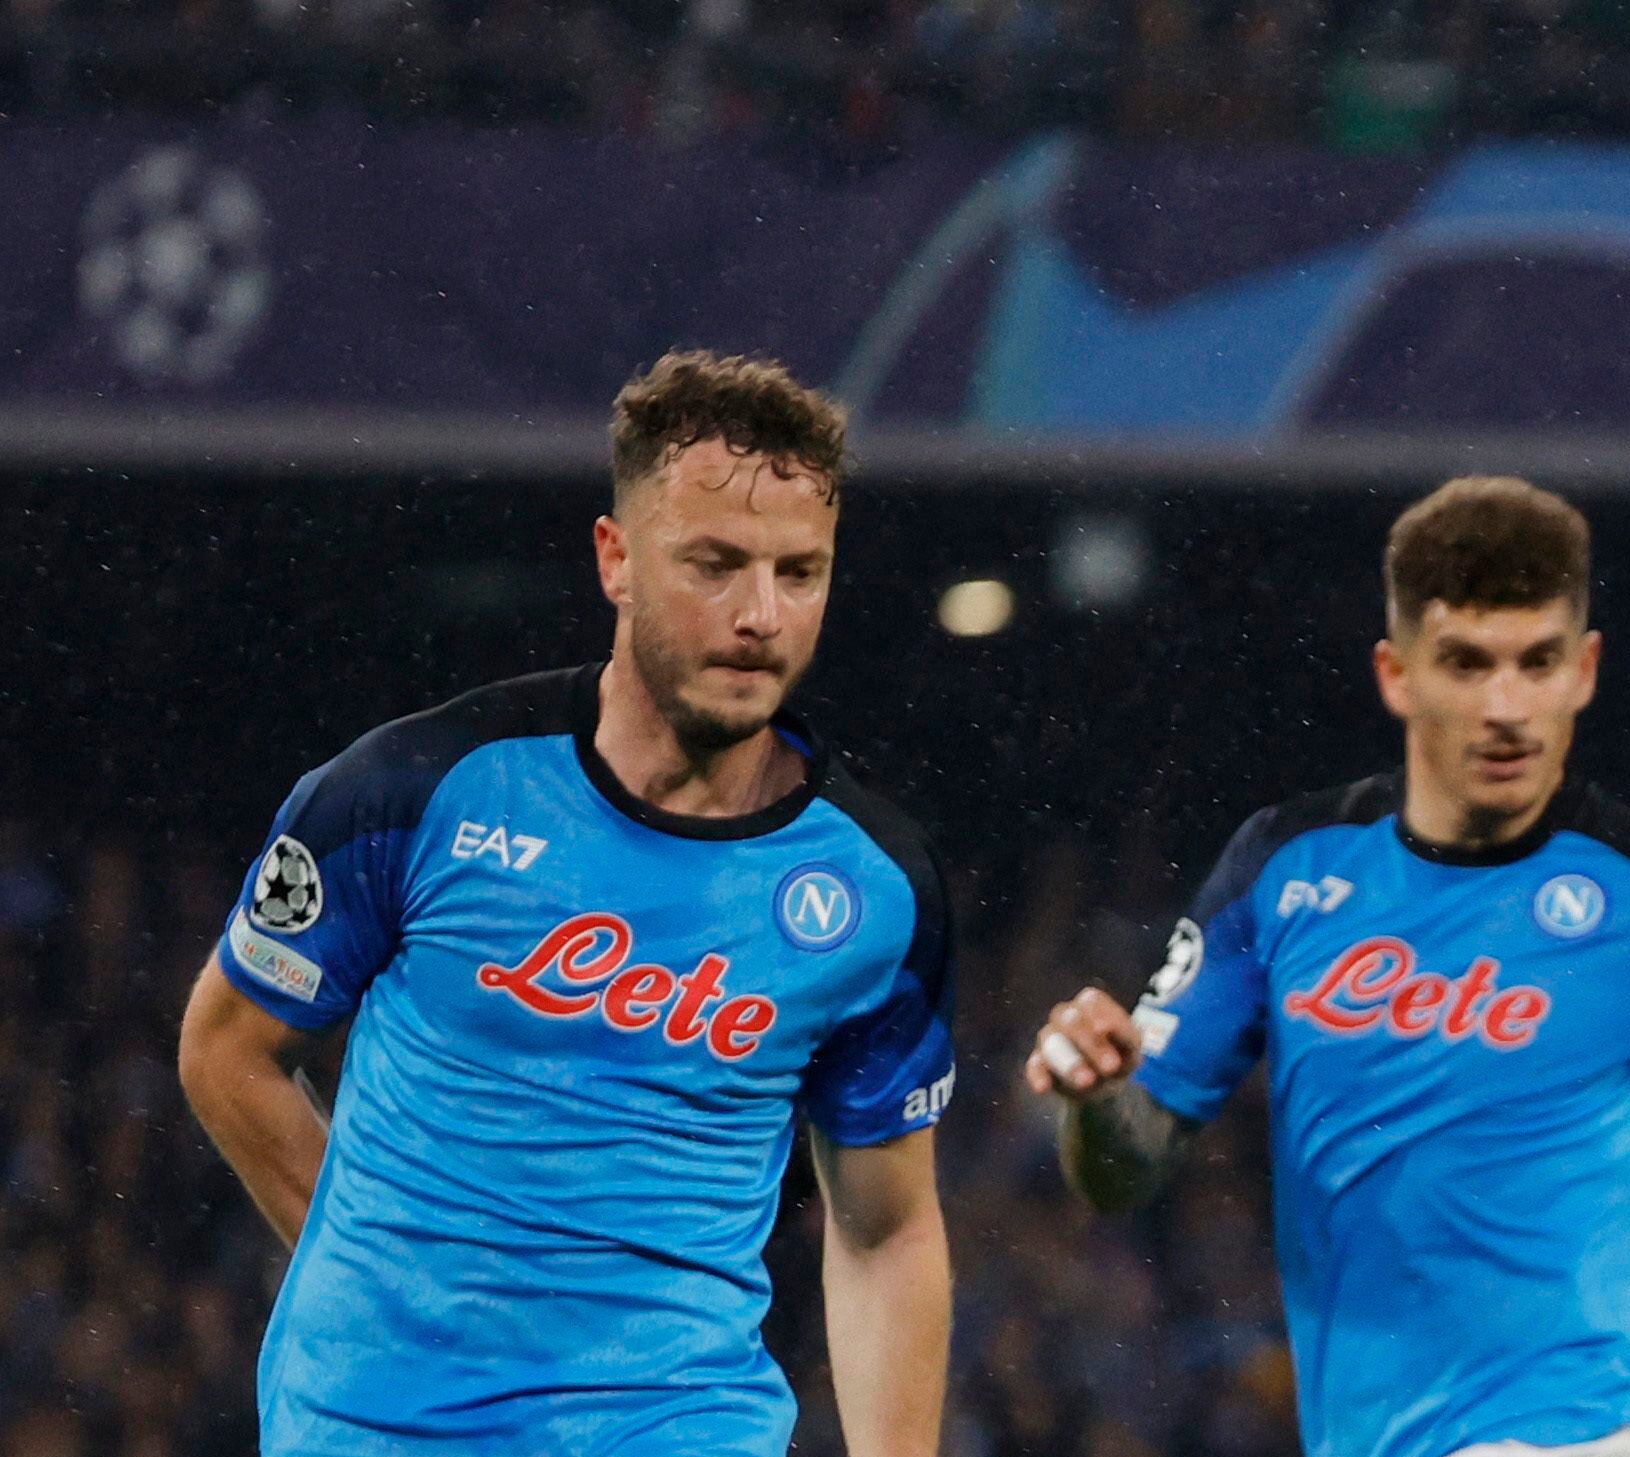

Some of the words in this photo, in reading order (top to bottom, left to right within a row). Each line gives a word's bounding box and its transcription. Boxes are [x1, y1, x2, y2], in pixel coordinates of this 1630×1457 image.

[451, 820, 549, 873] EA7
[477, 912, 778, 1063] Lete
[1283, 934, 1552, 1053] Lete
